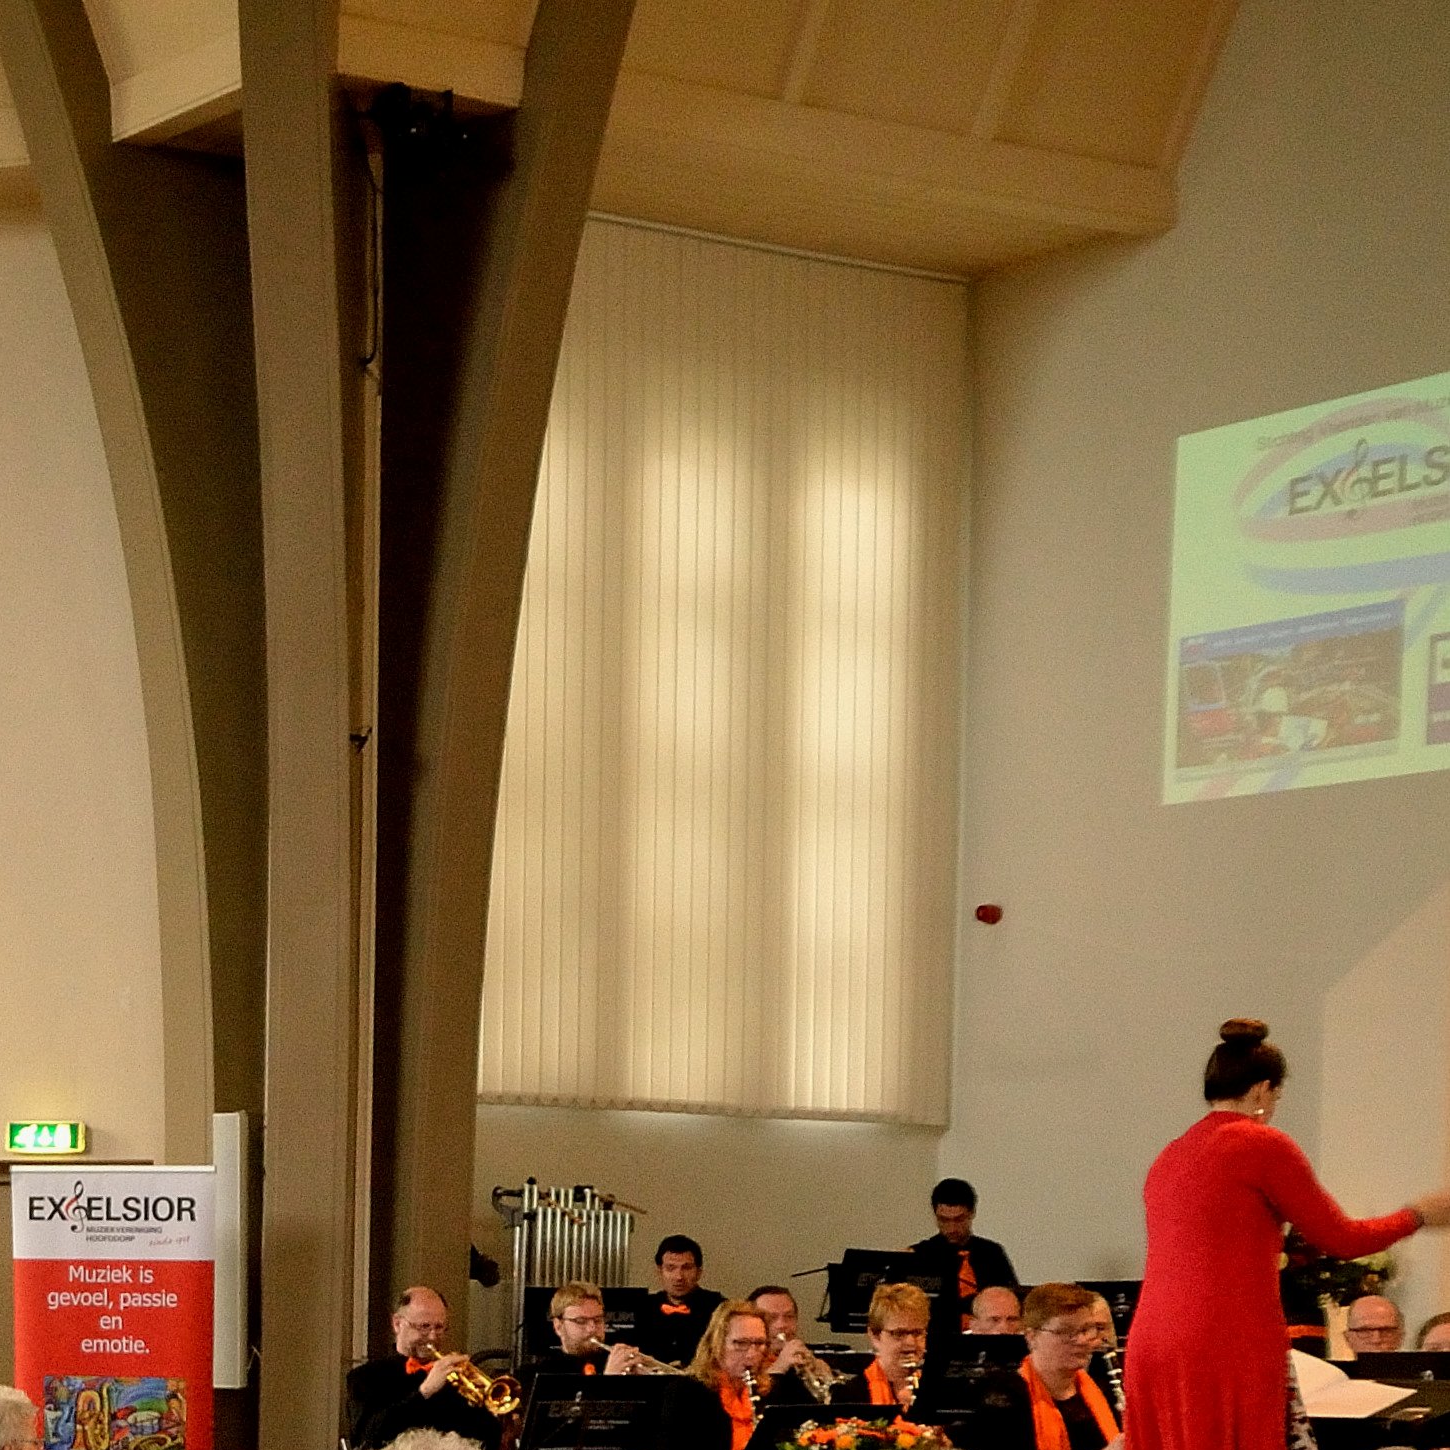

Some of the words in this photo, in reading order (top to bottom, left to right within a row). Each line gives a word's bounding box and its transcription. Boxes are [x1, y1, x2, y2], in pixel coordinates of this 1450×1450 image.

[68, 1265, 133, 1284] Muziek
[139, 1265, 154, 1284] is
[47, 1288, 114, 1310] gevoel,
[119, 1289, 178, 1310] passie
[99, 1314, 124, 1330] en
[81, 1335, 150, 1354] emotie.
